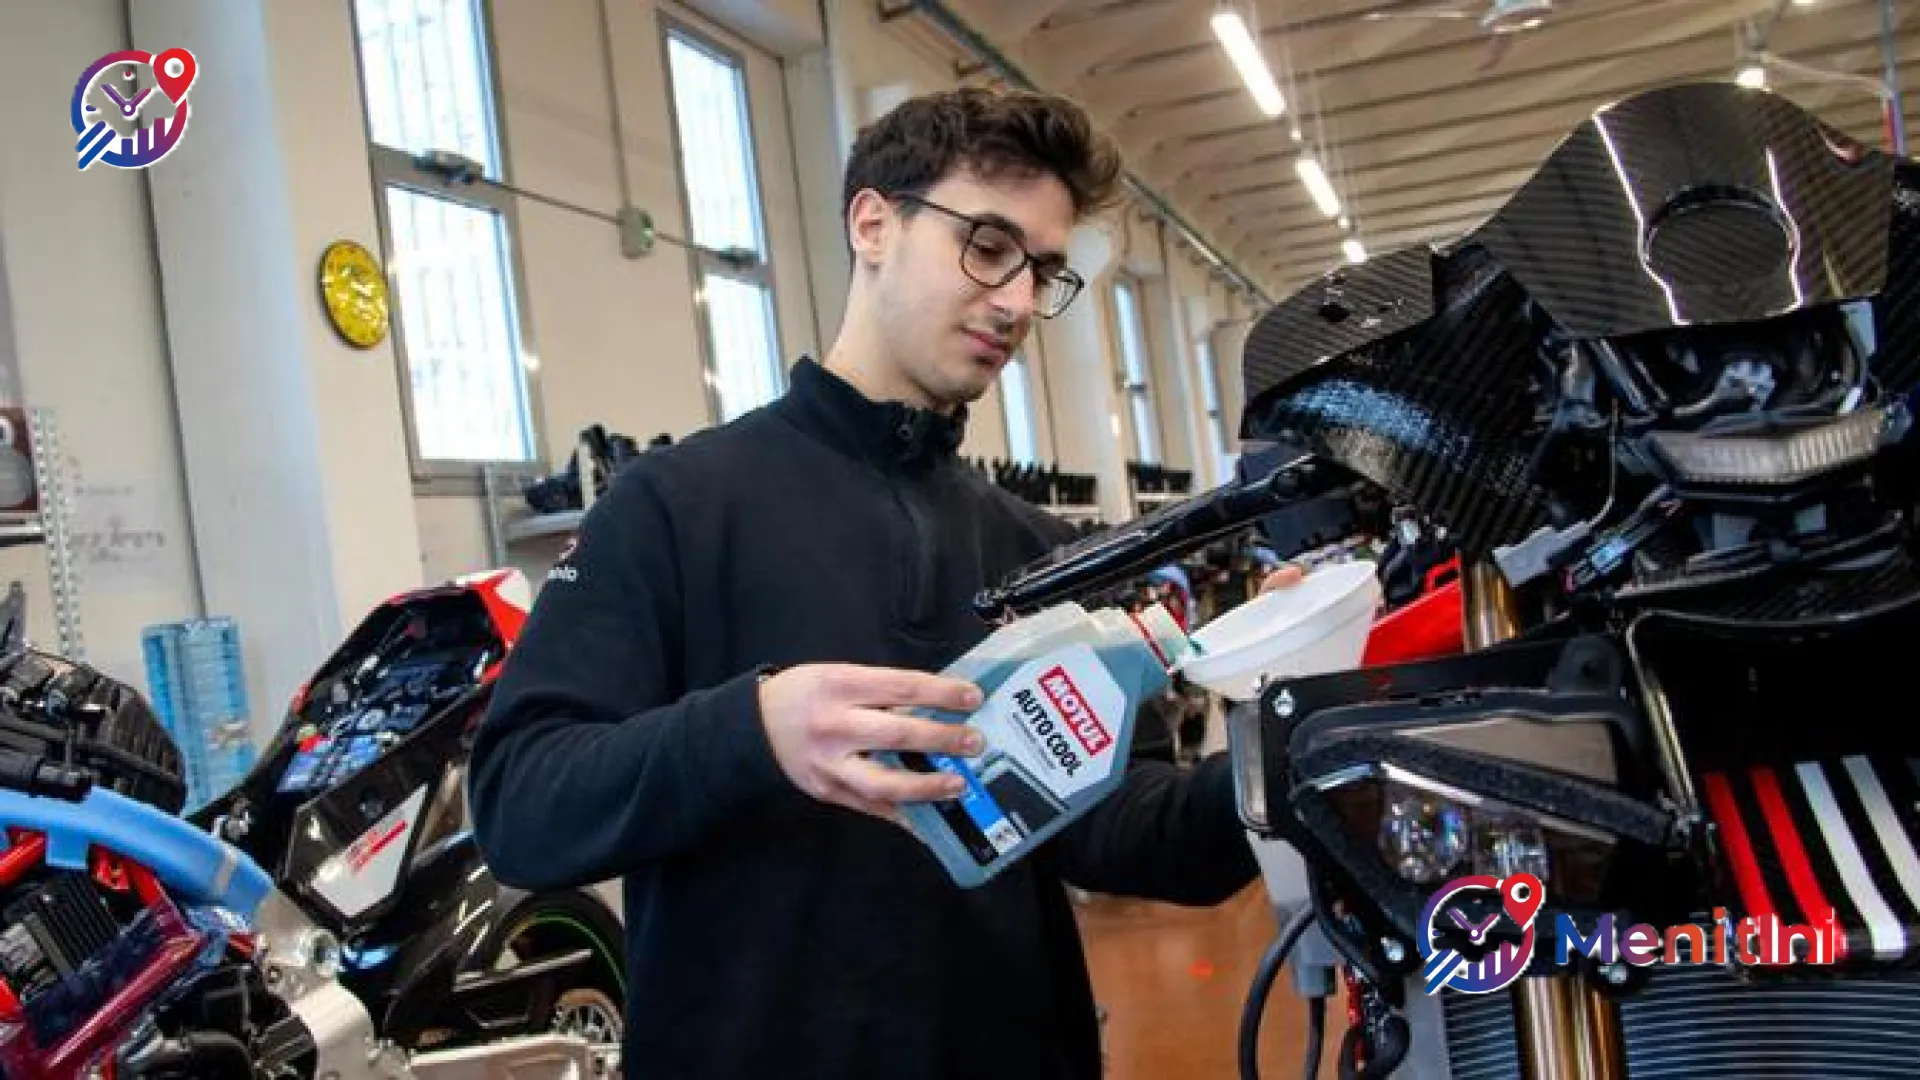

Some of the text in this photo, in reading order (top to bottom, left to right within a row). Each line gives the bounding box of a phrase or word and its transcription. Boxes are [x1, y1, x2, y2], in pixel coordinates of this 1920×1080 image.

[1013, 689, 1054, 736] AUTO
[1046, 732, 1082, 778] COOL
[1040, 673, 1108, 752] MOTUL
